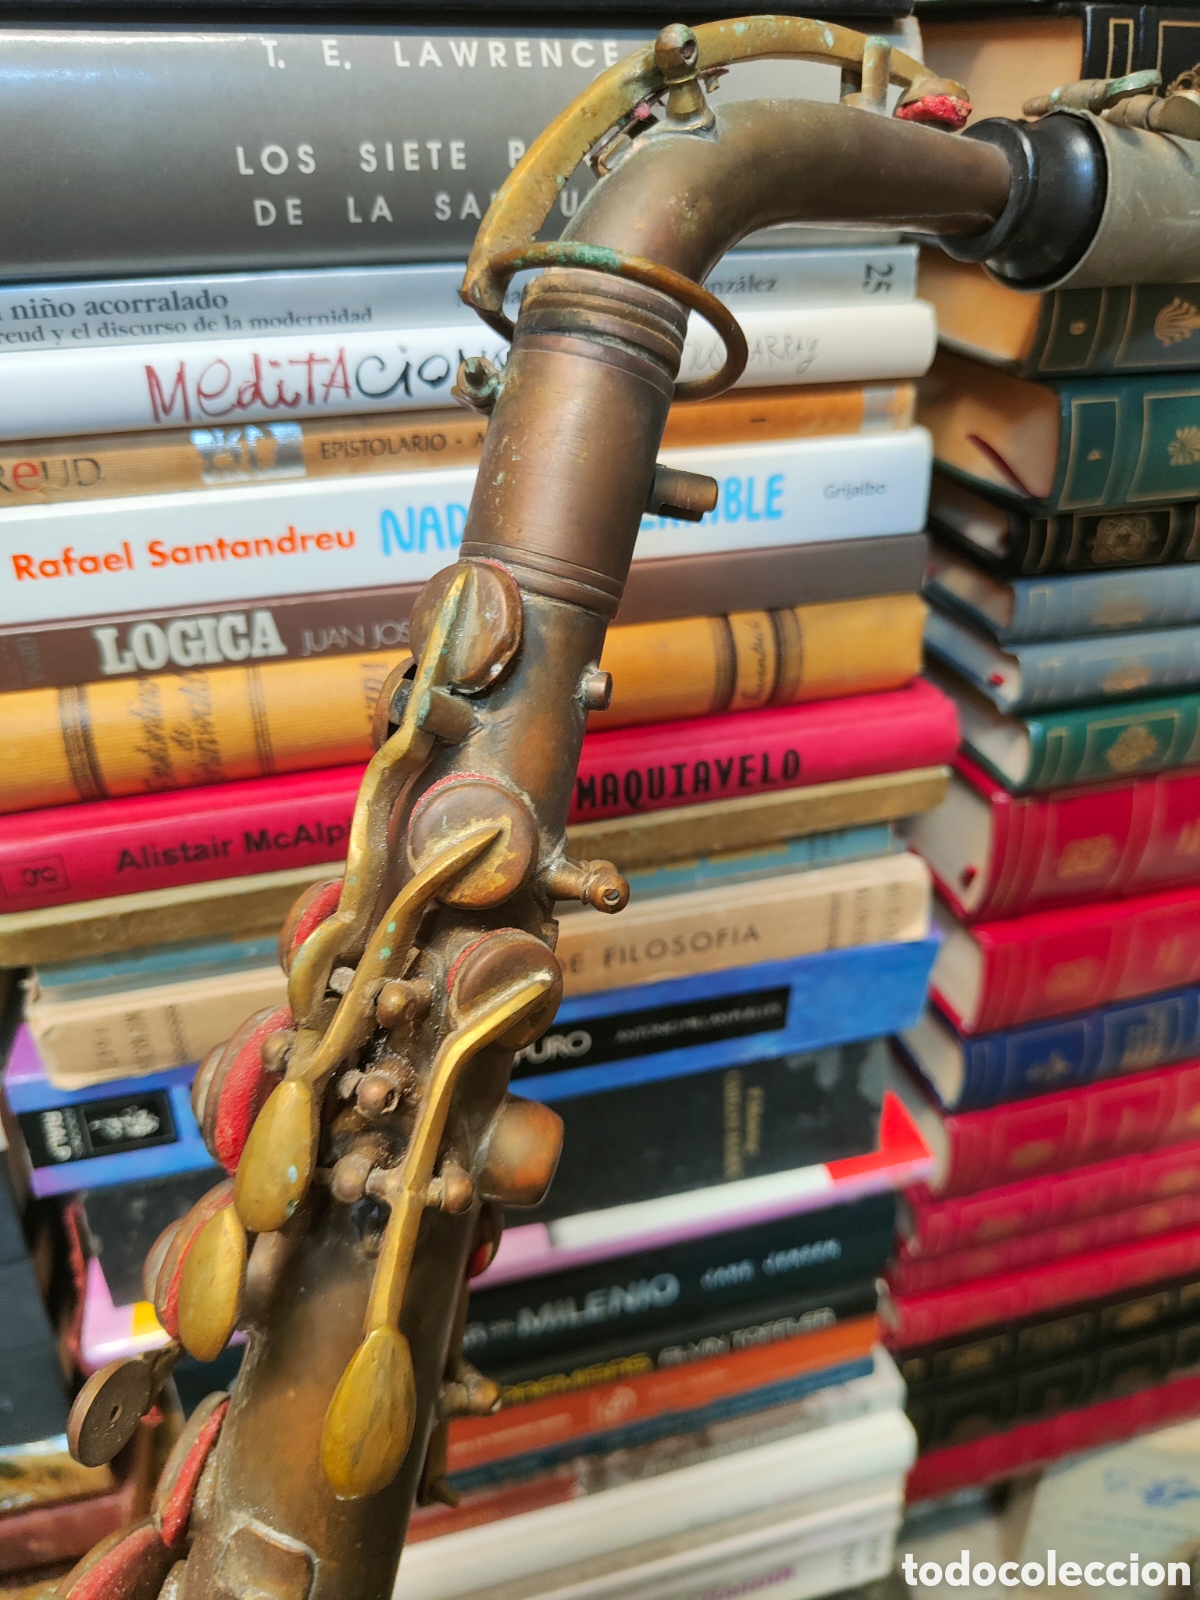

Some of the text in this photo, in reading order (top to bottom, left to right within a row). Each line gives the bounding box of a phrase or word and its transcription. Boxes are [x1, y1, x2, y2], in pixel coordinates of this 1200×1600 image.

[262, 39, 619, 70] T. E. LAWRENCE
[237, 140, 467, 175] LOS SIETE
[253, 195, 393, 227] DE LA
[863, 262, 893, 295] 25
[11, 289, 229, 320] niño acorralado
[51, 329, 65, 346] y
[72, 323, 91, 340] el
[98, 318, 188, 339] discurso
[194, 316, 218, 333] de
[224, 314, 242, 330] la
[249, 306, 373, 330] modernidad
[321, 433, 447, 460] EPISTOLARIO
[12, 542, 136, 582] Rafael
[147, 525, 356, 568] Santandreu
[93, 609, 288, 675] LOGICA
[302, 624, 365, 656] JUAN
[577, 749, 800, 811] MAQUIAVELO
[118, 837, 233, 873] Alistair
[604, 924, 761, 968] FILOSOFIA
